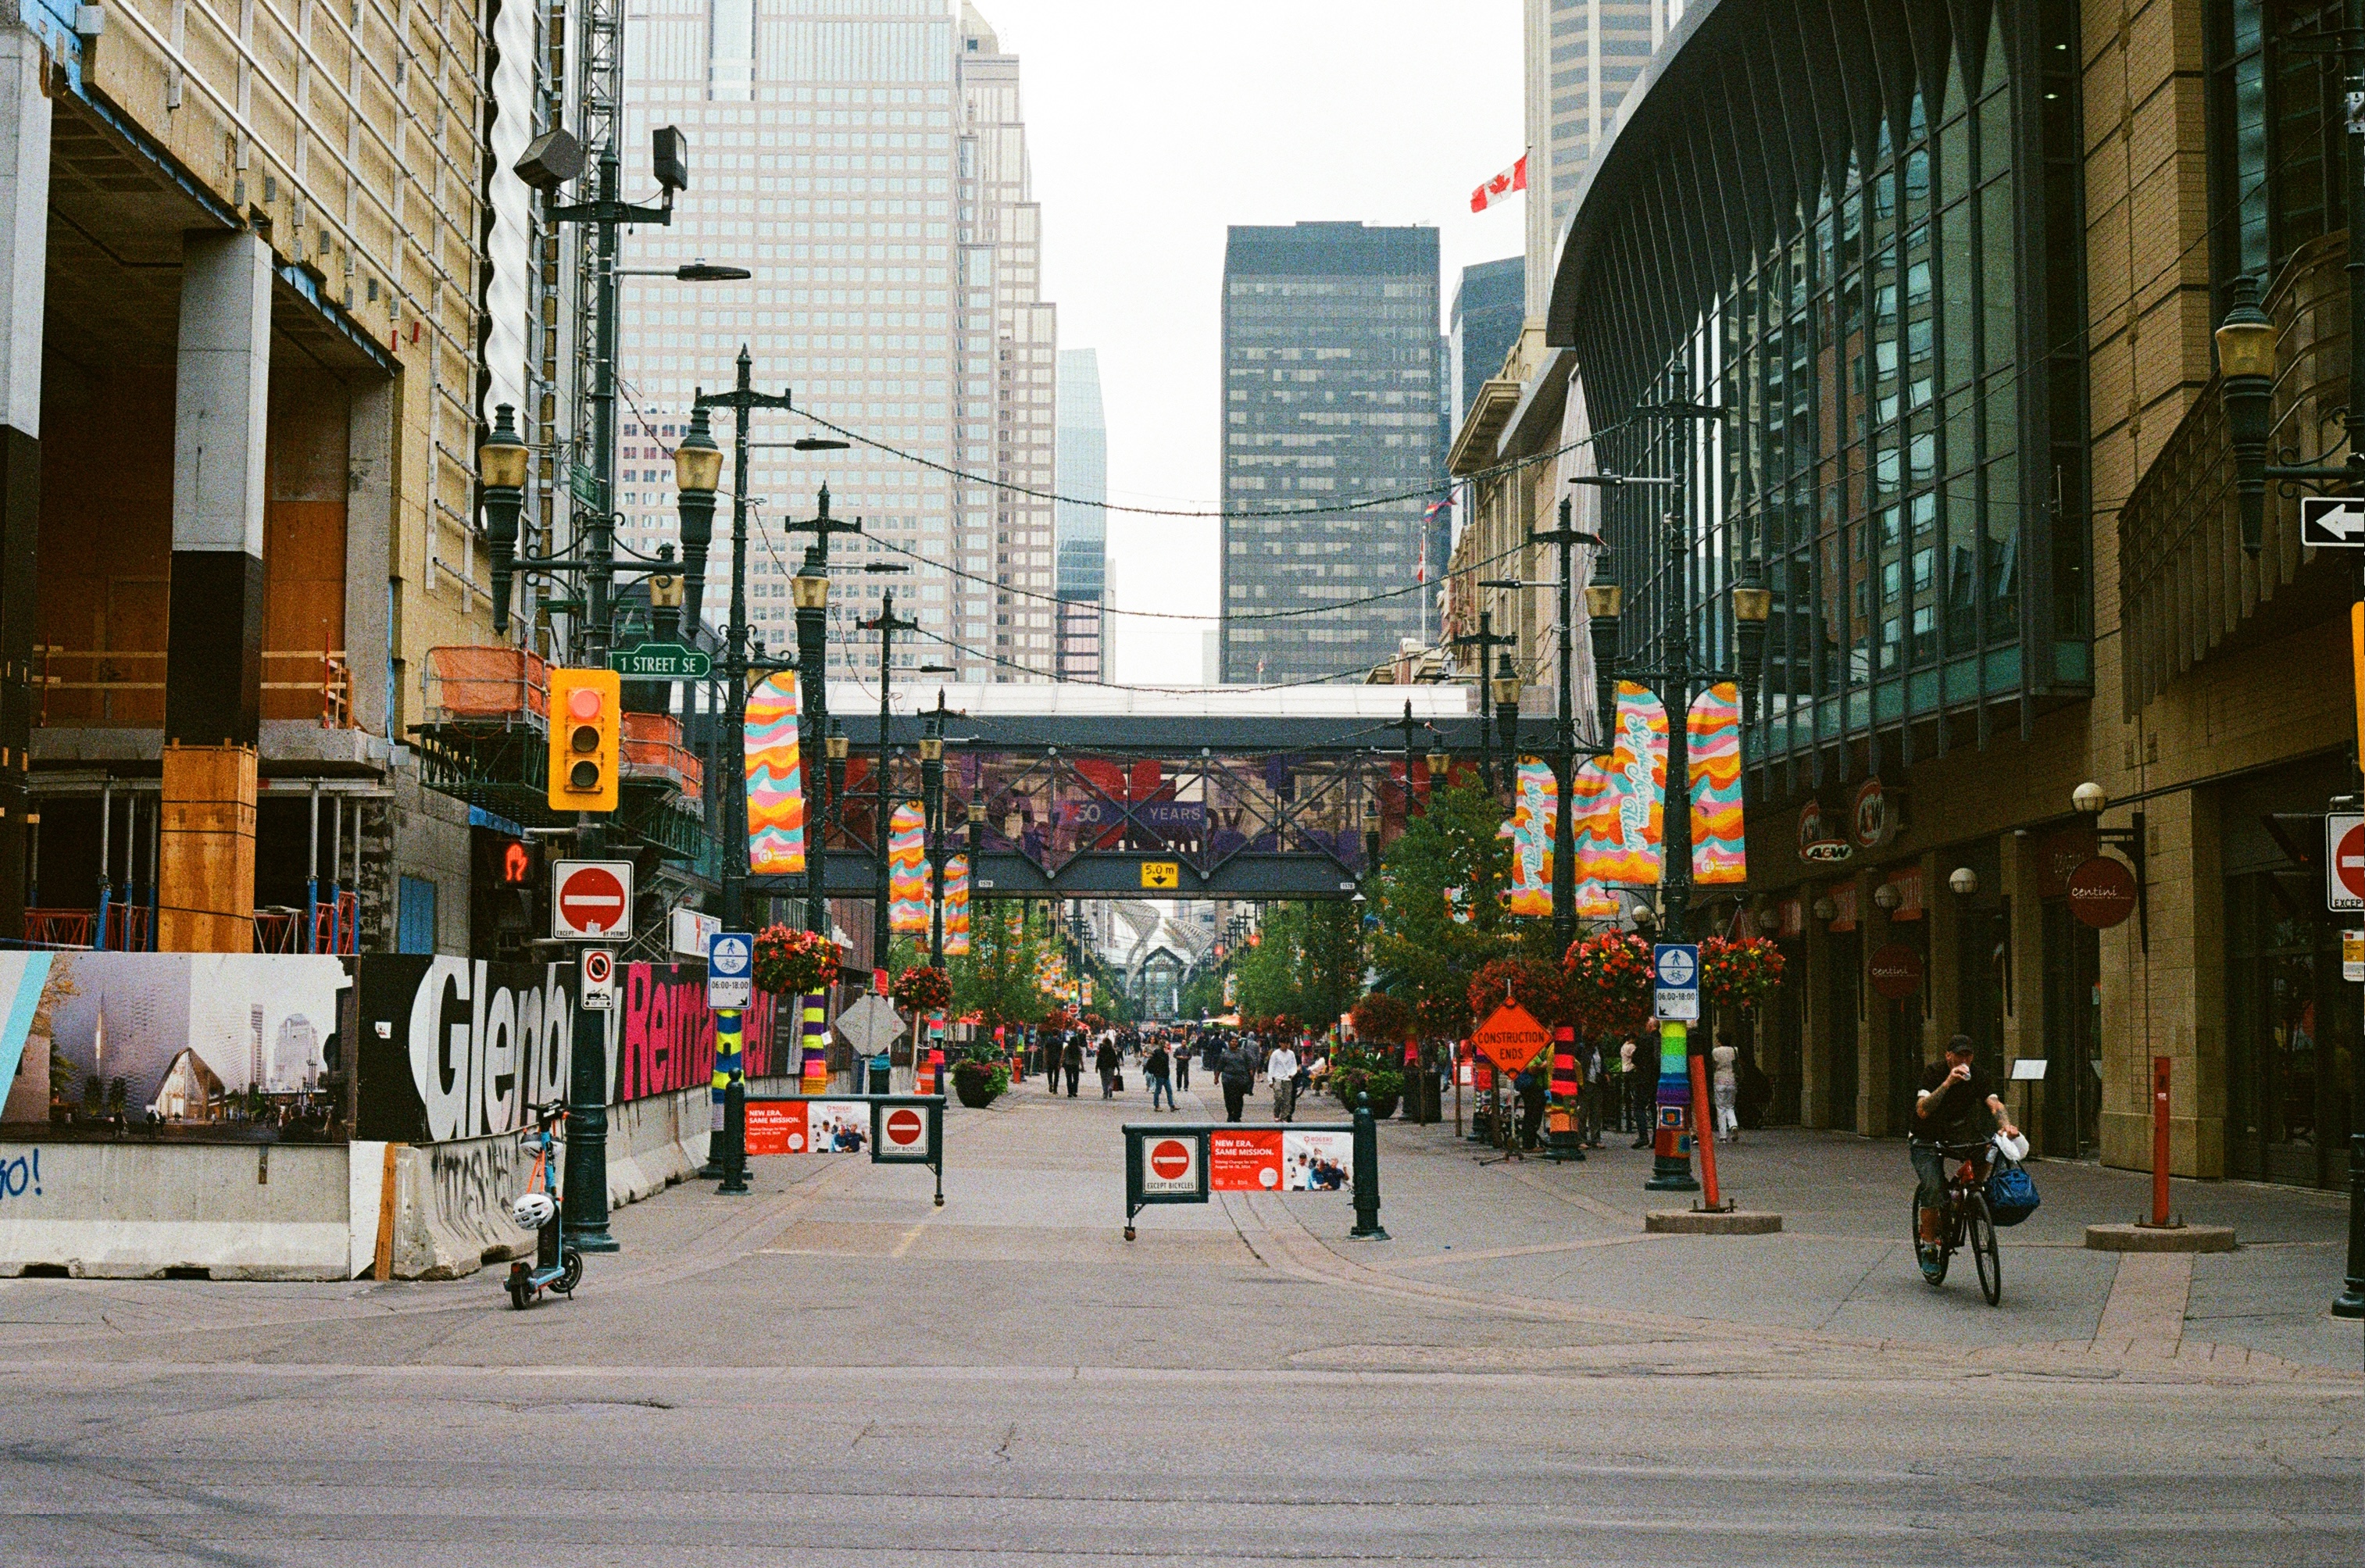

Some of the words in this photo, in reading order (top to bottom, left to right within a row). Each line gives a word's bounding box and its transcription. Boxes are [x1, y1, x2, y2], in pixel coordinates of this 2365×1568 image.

[620, 657, 627, 671] 1
[633, 656, 676, 672] STREET
[682, 658, 696, 673] SE
[1075, 804, 1101, 823] 50
[1149, 805, 1201, 822] YEARS
[1809, 846, 1850, 859] A&W
[1145, 865, 1163, 875] 5.0
[712, 980, 748, 990] 06:00-18:00
[1657, 992, 1695, 1001] 06:00-18:00
[1477, 1031, 1545, 1044] CONSTRUCTION
[1499, 1048, 1524, 1060] ENDS
[1235, 1140, 1254, 1148] ERA,
[1238, 1148, 1274, 1156] MISSION.
